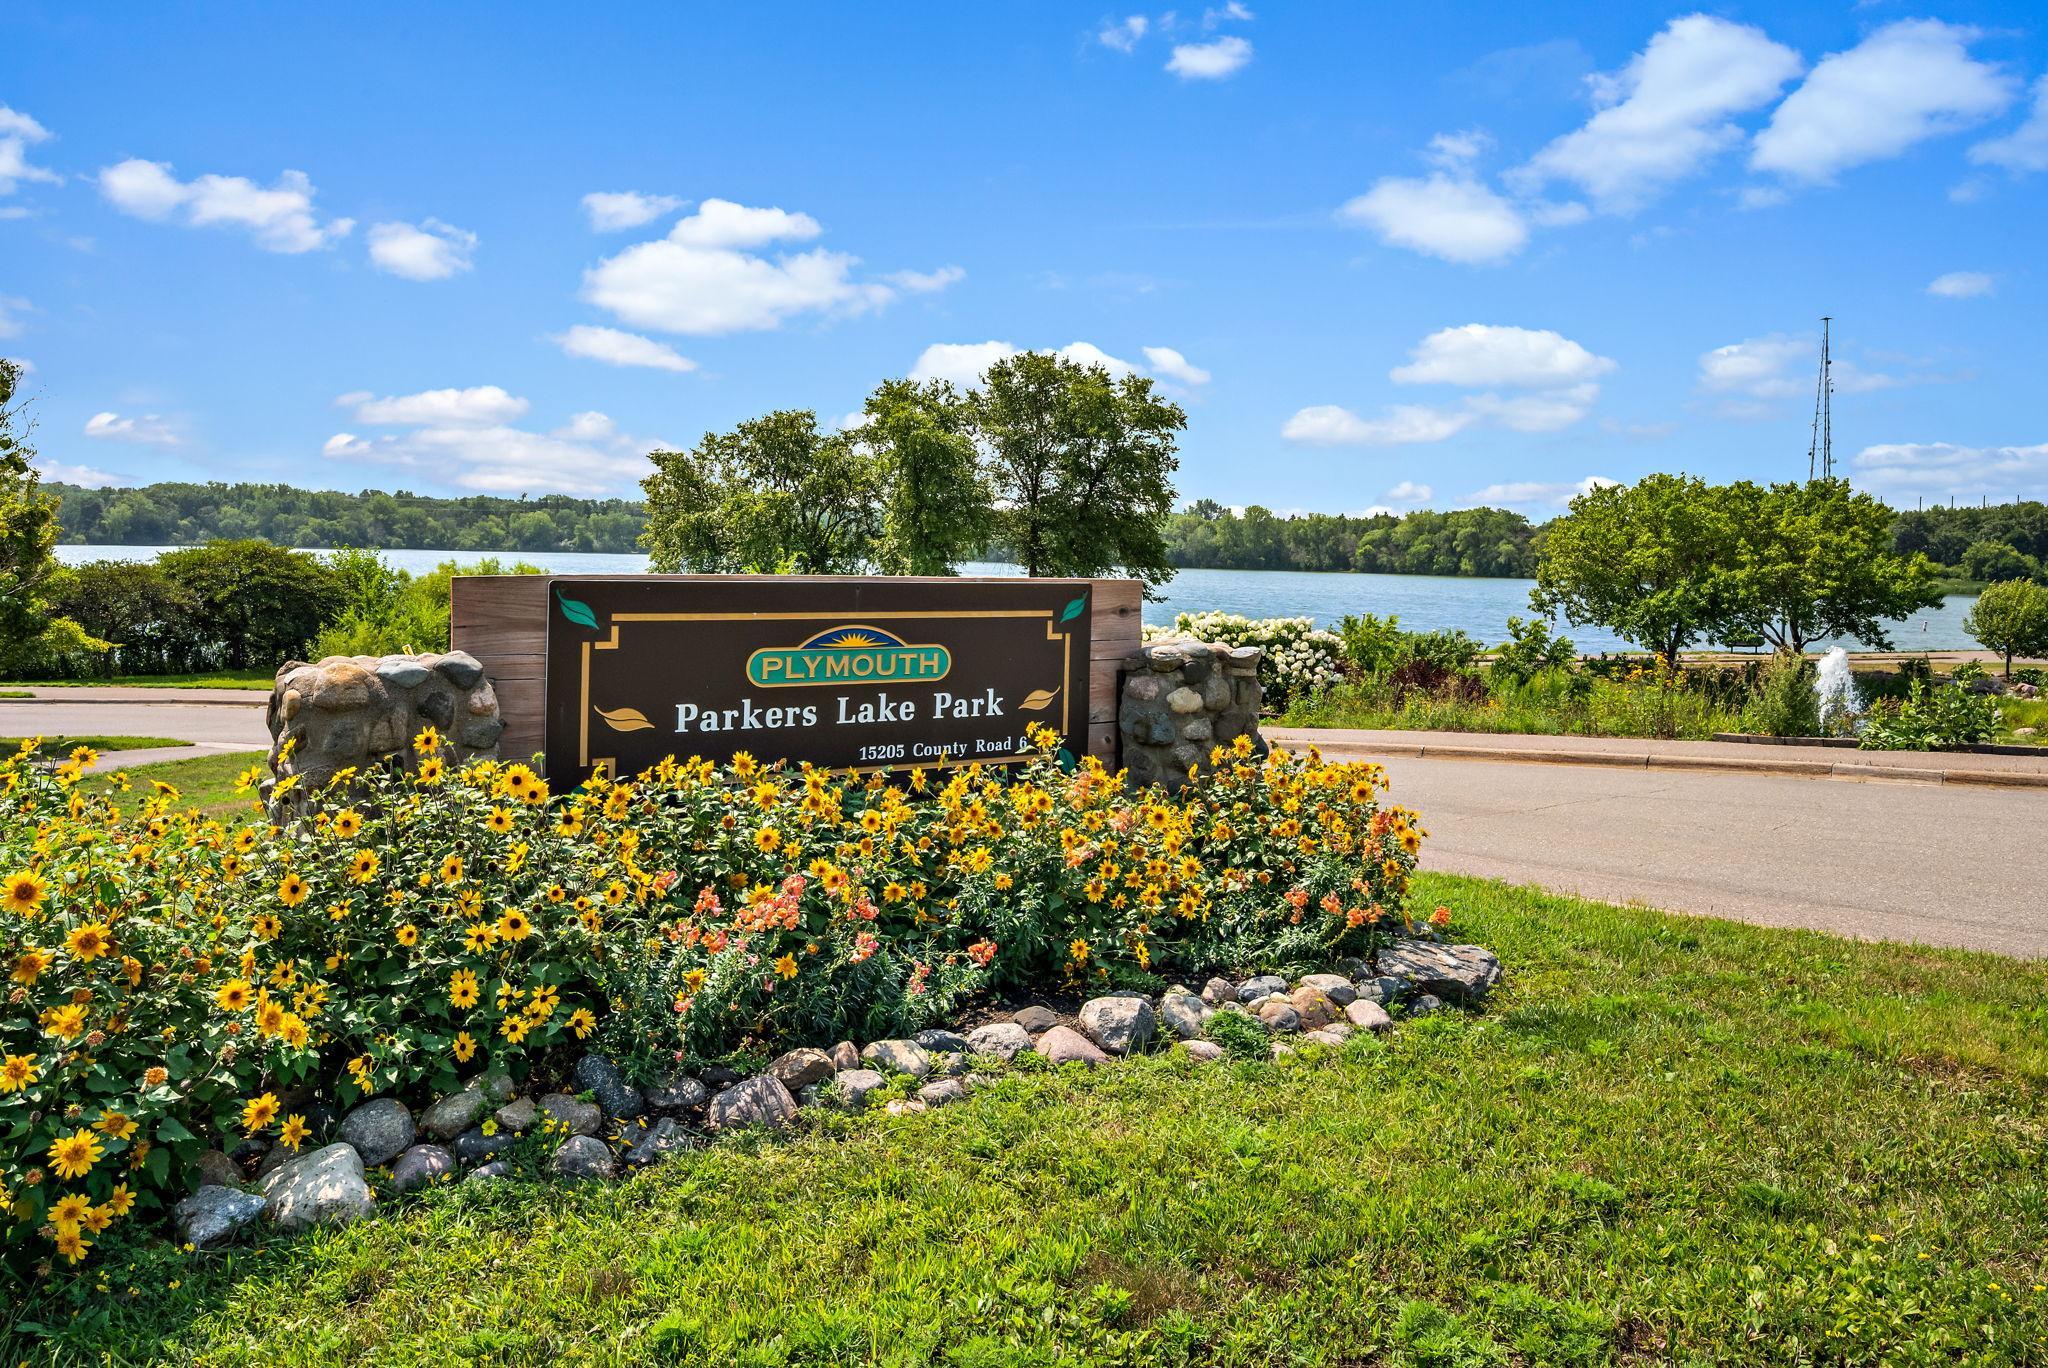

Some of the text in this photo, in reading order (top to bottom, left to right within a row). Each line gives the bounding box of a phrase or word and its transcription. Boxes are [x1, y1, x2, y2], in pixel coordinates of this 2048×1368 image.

[761, 652, 939, 680] PLYMOUTH
[674, 688, 1004, 733] Parkers Lake Park
[859, 736, 1029, 760] 15205 County Road 6
